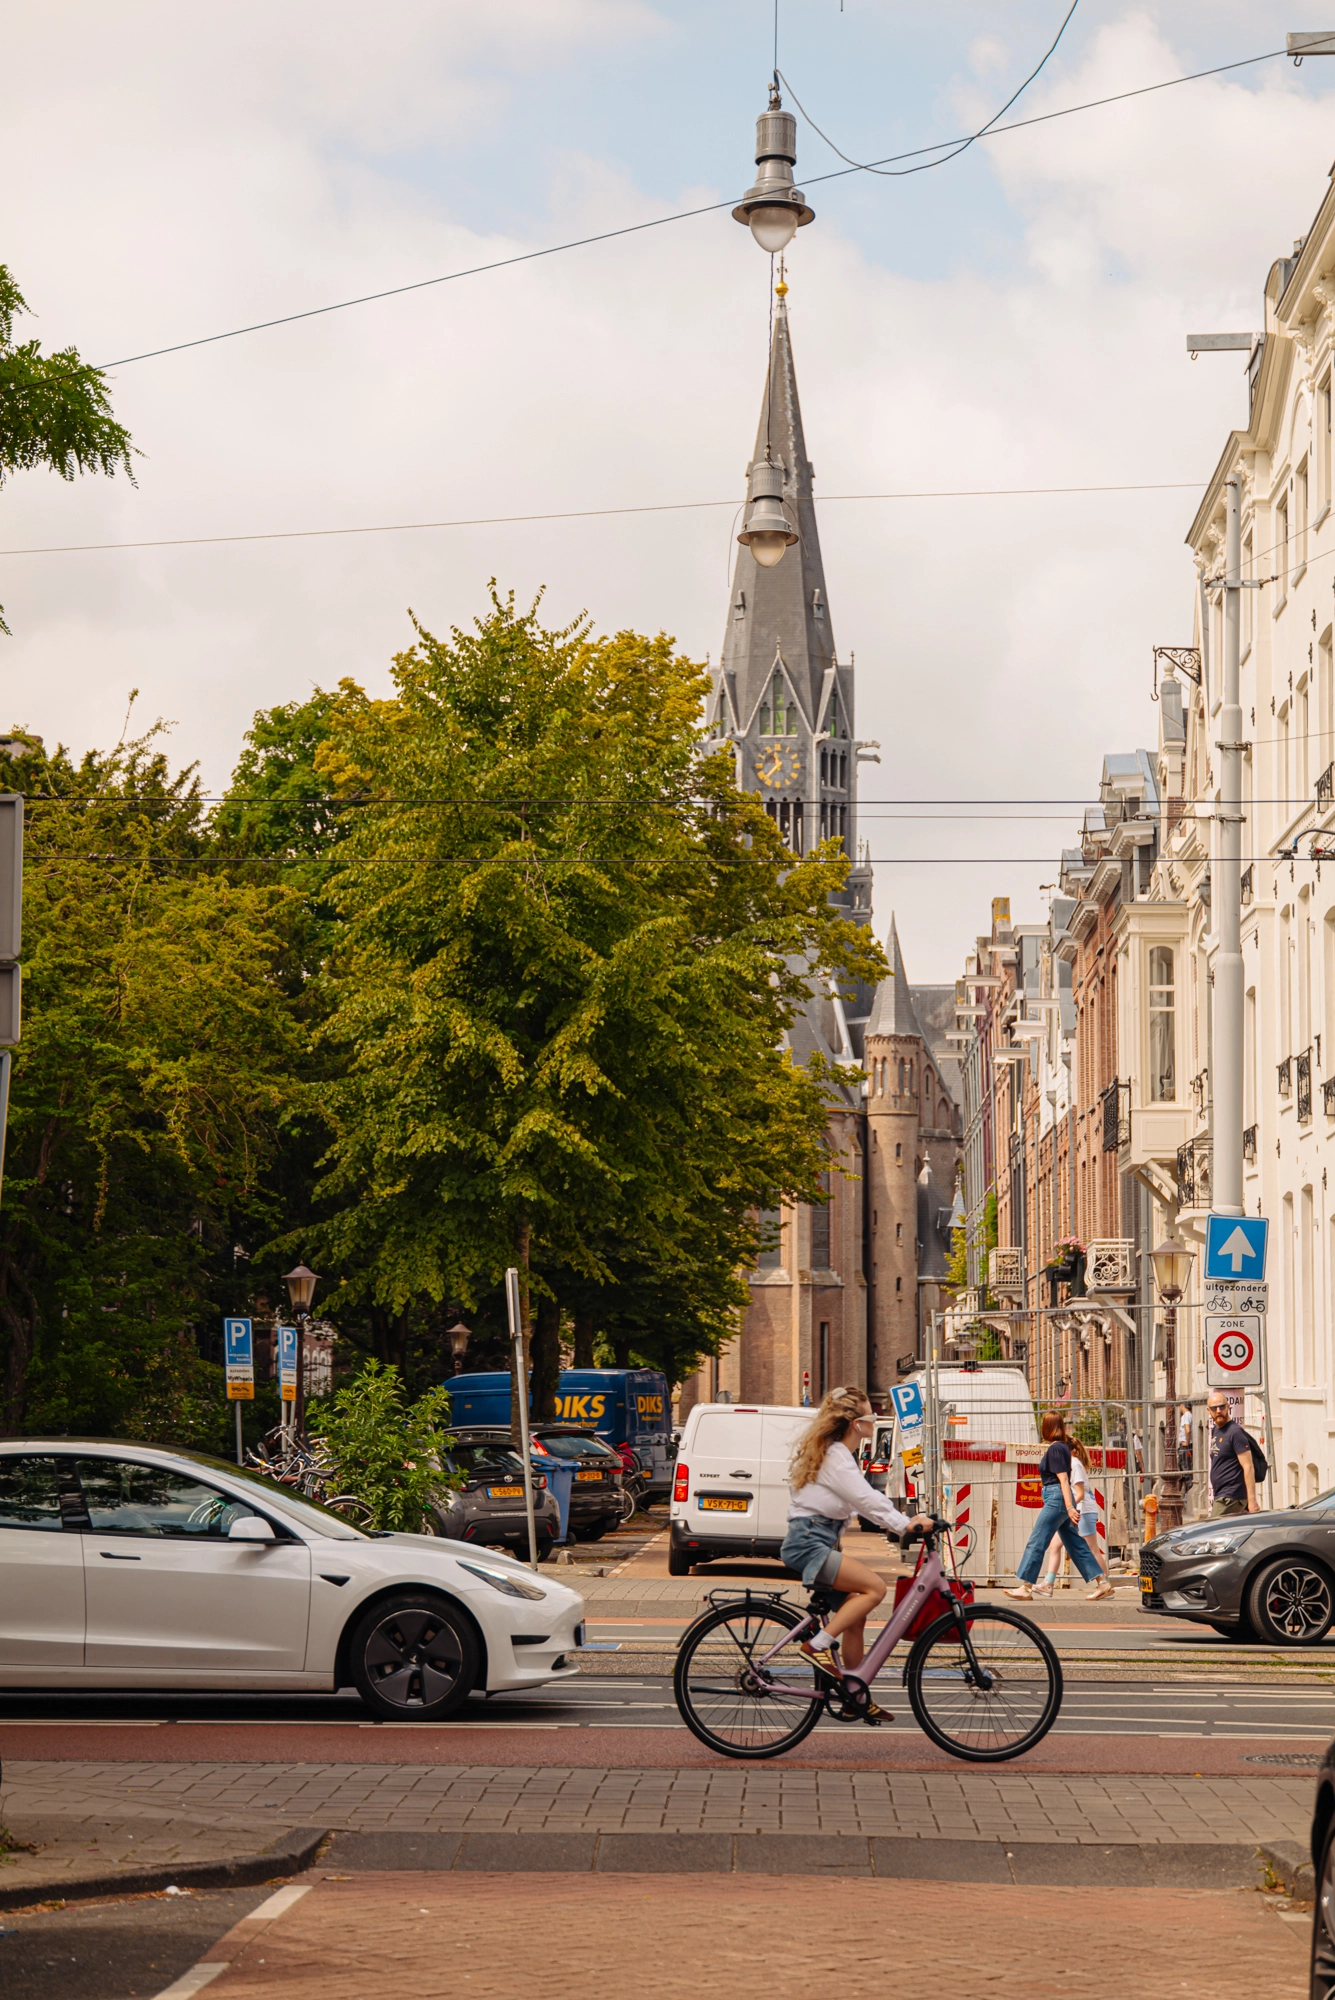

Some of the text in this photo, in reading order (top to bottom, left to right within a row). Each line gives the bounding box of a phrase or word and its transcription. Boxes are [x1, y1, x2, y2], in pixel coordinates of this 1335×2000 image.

[1206, 1283, 1267, 1293] uitgezonderd
[1220, 1320, 1245, 1328] ZONE
[231, 1322, 246, 1346] P
[283, 1331, 294, 1353] P
[1221, 1343, 1246, 1358] 30
[637, 1395, 663, 1414] DIKS
[897, 1387, 915, 1412] P
[1015, 1449, 1046, 1457] gpgroot.
[707, 1499, 743, 1509] VSK-71-G
